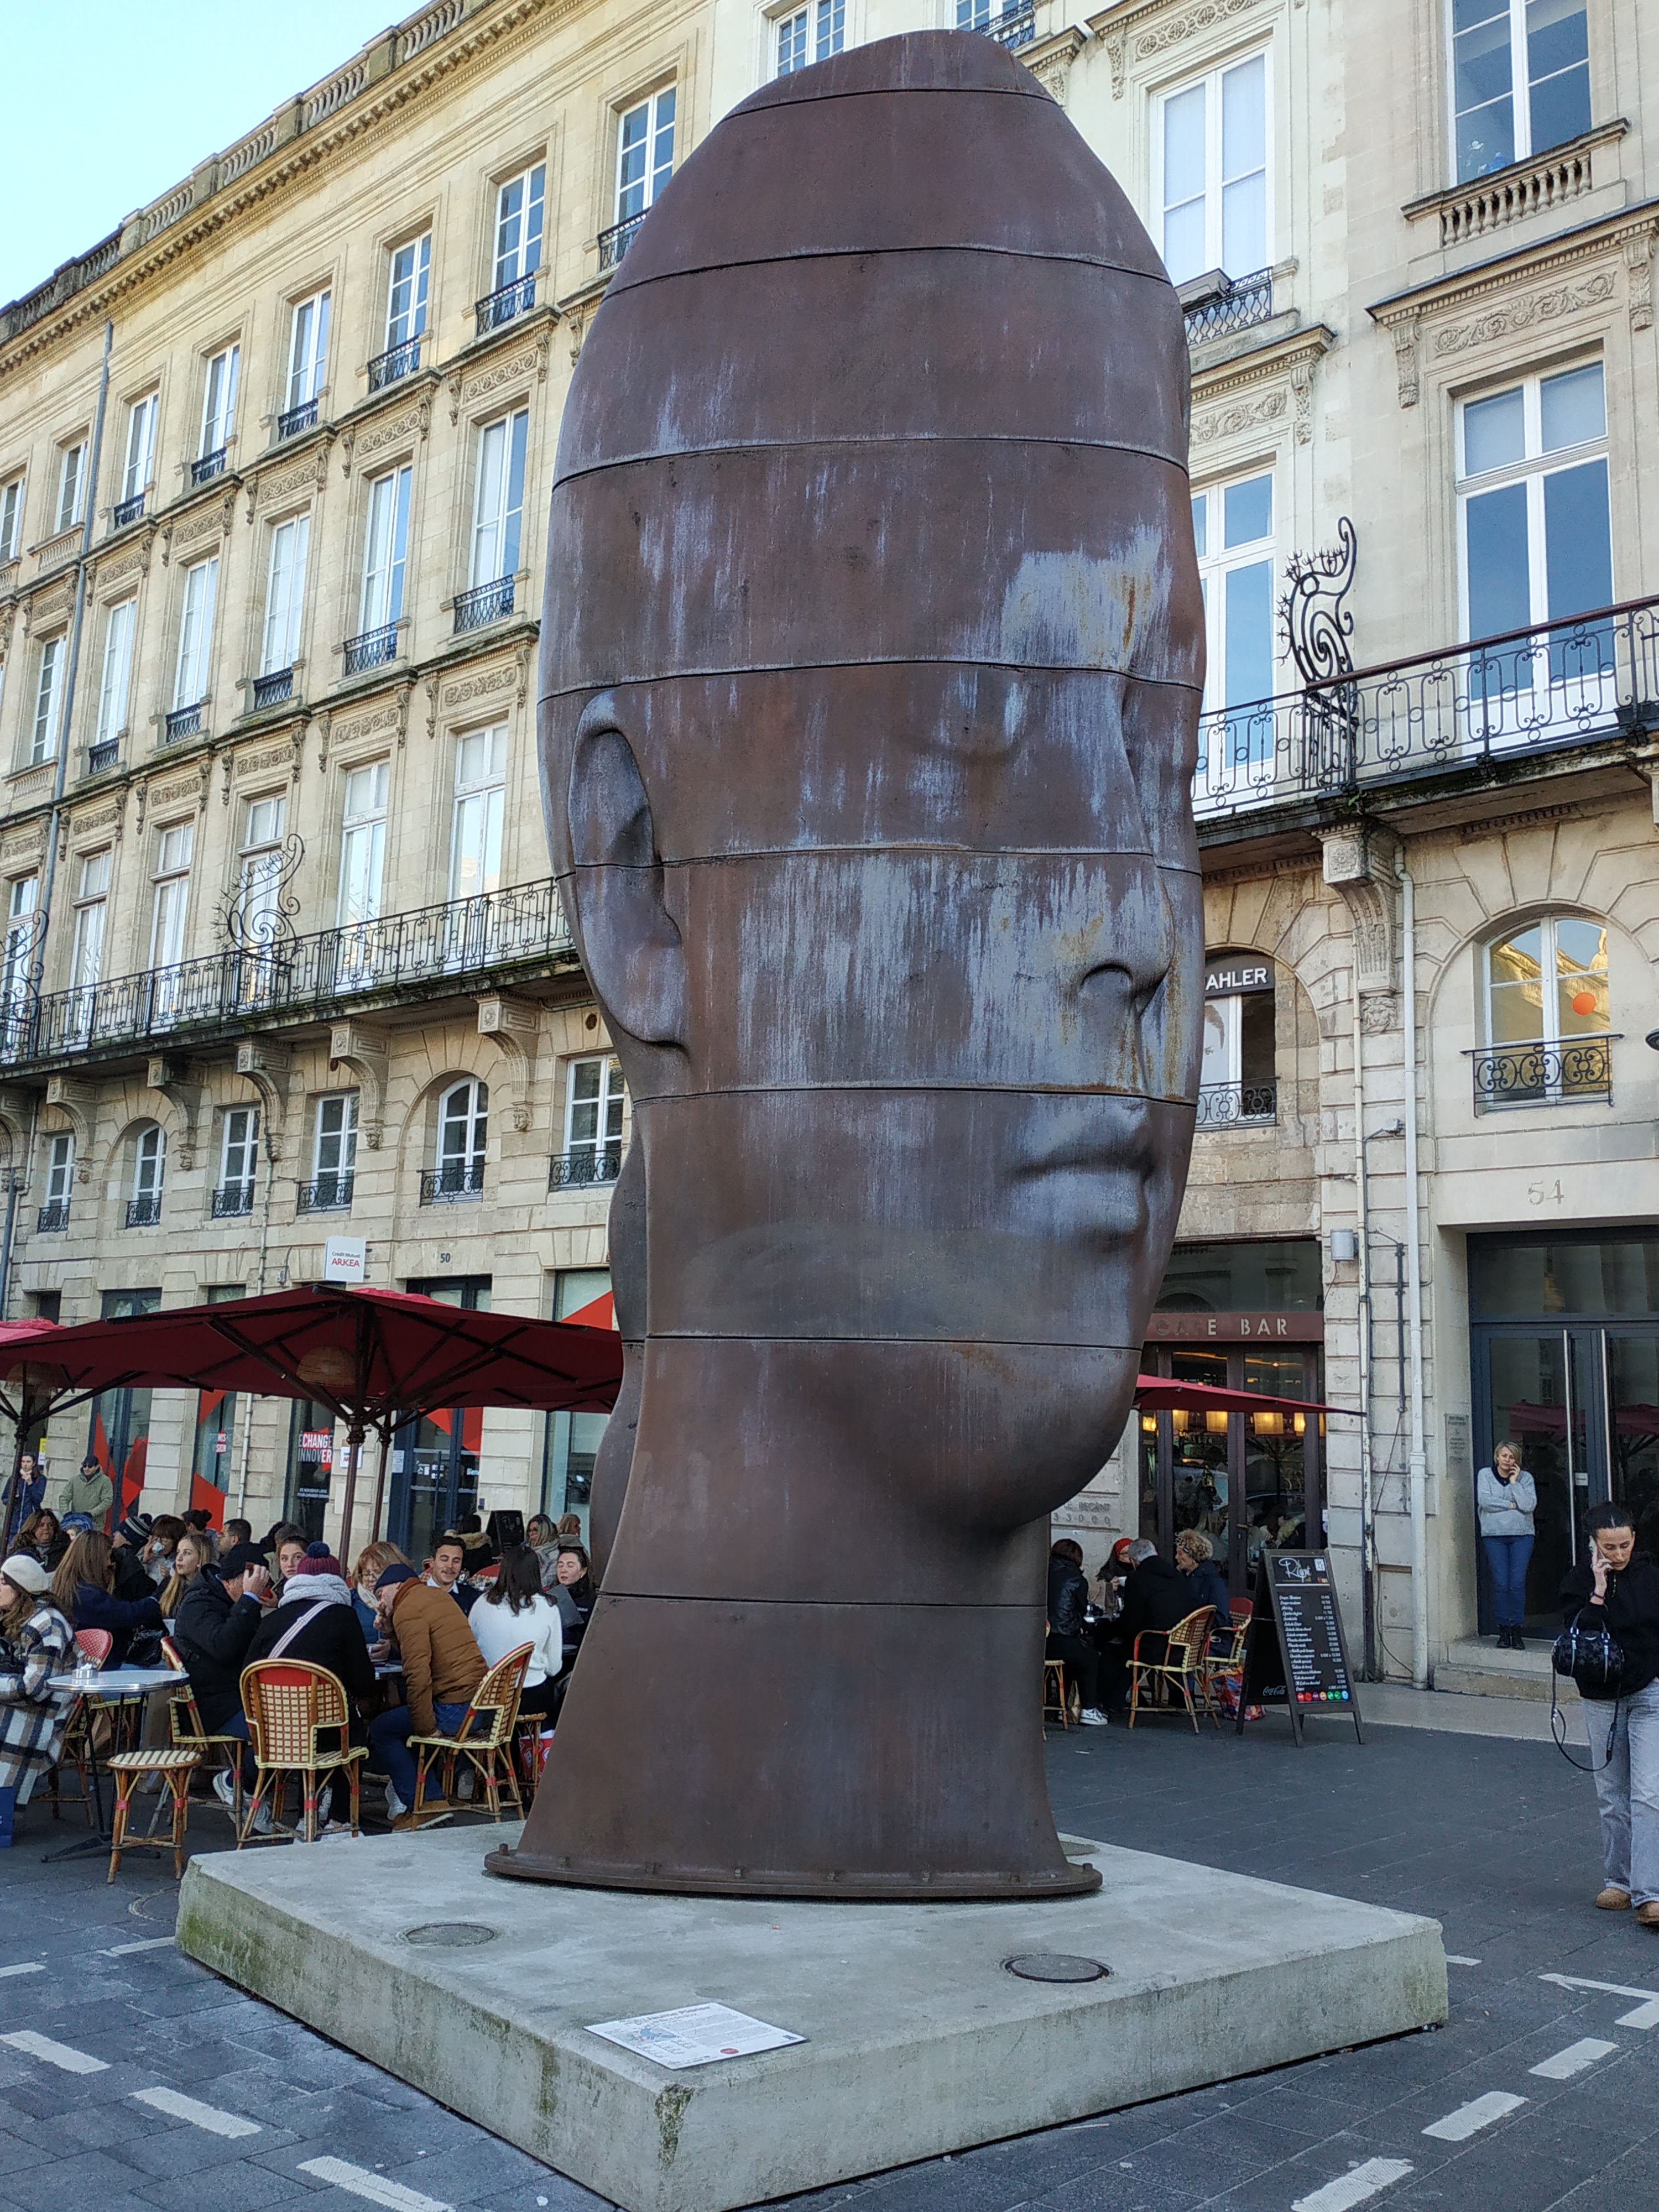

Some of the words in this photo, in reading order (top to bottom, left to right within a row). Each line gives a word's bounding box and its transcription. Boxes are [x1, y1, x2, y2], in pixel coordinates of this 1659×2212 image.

[1527, 1179, 1564, 1205] 54
[331, 1258, 360, 1267] ARKEA
[440, 1253, 451, 1264] 50
[1241, 1318, 1287, 1335] BAR
[298, 1448, 332, 1463] INNOVER
